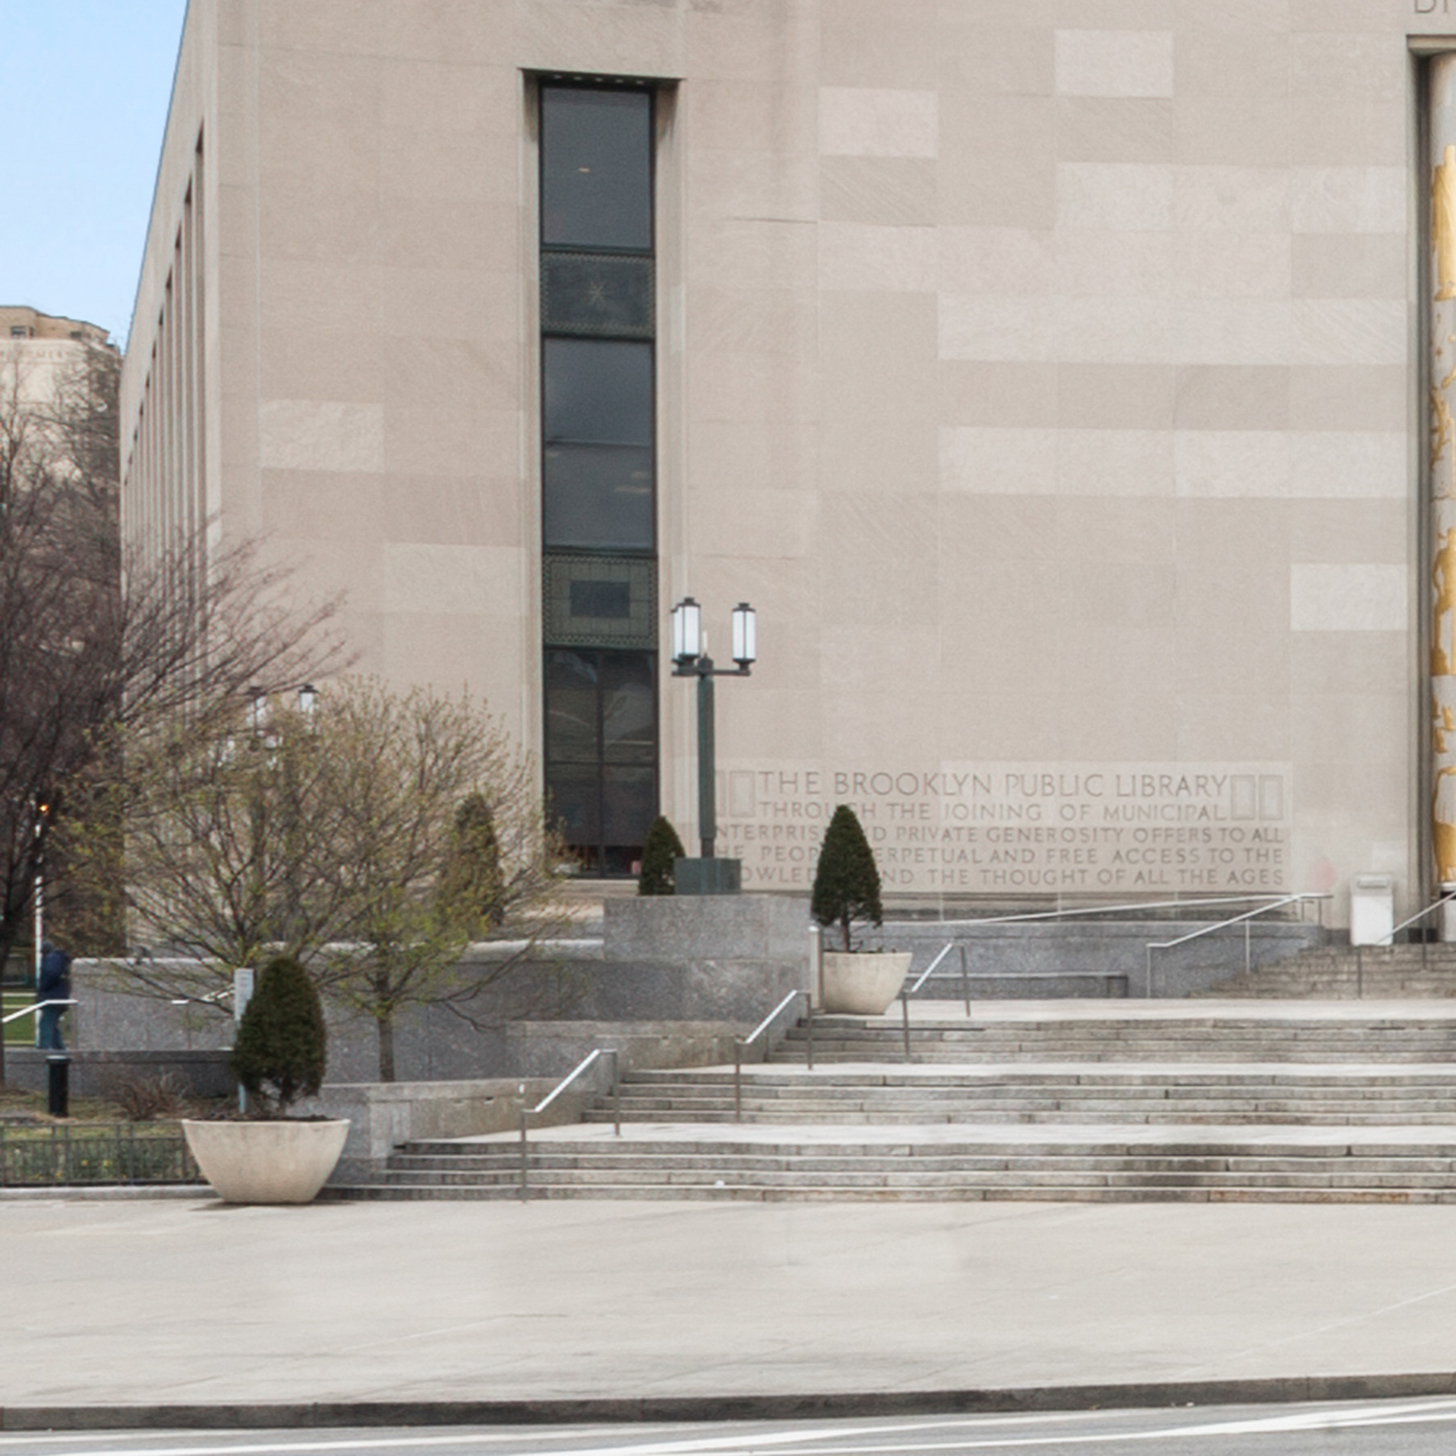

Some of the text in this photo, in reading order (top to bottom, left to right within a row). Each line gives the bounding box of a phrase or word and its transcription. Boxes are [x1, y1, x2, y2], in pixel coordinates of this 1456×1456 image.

[758, 771, 1228, 798] THE BROOKLYN PUBLIC LIBRARY
[886, 802, 931, 820] THE
[944, 802, 1042, 821] JOINING
[1058, 803, 1091, 822] OF
[1103, 804, 1227, 822] MUNICIPAL
[716, 824, 820, 842] NTERPRIS
[898, 825, 979, 842] PRIVATE
[986, 826, 1125, 843] GENEROSITY
[1133, 827, 1213, 844] OFFERS
[1217, 827, 1247, 843] TO
[1251, 827, 1285, 843] ALL
[715, 845, 1284, 864] HE PEOP ERPETUAL AND FREE ACCESS TO THE
[881, 867, 914, 884] ND
[927, 869, 969, 885] THE
[980, 869, 1089, 886] THOUGHT
[1097, 869, 1133, 885] OF
[1133, 869, 1170, 885] ALL
[1178, 869, 1218, 885] THE
[1226, 869, 1284, 885] AGES
